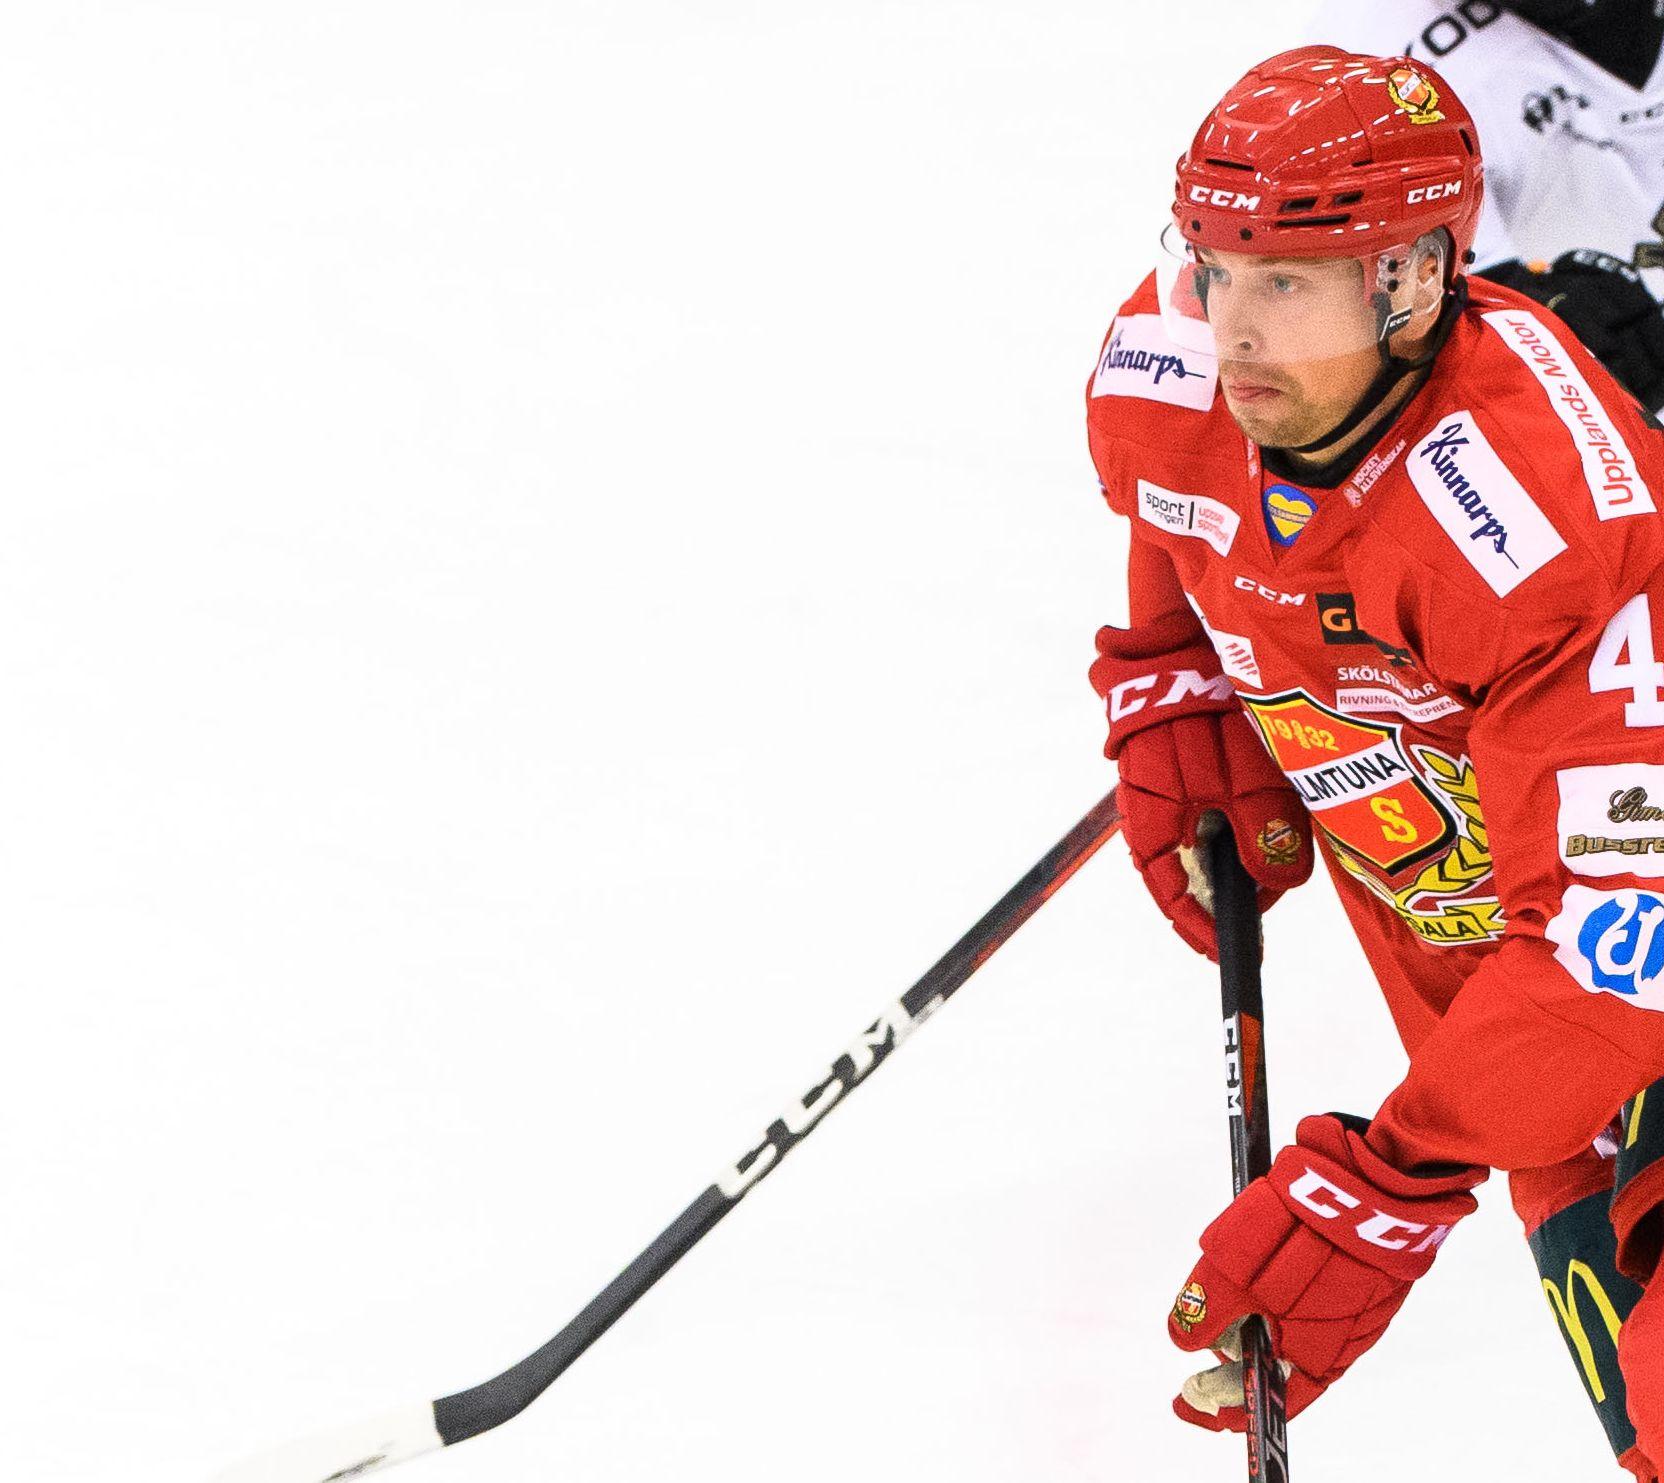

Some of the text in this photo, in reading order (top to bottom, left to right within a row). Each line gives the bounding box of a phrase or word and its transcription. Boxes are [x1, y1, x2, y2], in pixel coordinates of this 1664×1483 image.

[1189, 184, 1261, 211] CCM
[1406, 179, 1462, 205] CCM
[1505, 318, 1634, 506] Upplands Motor
[1351, 453, 1382, 487] HOCKEY
[1145, 492, 1186, 516] sport
[1419, 423, 1520, 570] Kinnarps
[1233, 575, 1307, 606] CCM
[1339, 695, 1393, 706] RIVNING
[1294, 752, 1407, 802] LMTUNA
[1370, 796, 1419, 844] S
[1223, 1018, 1243, 1117] CCM
